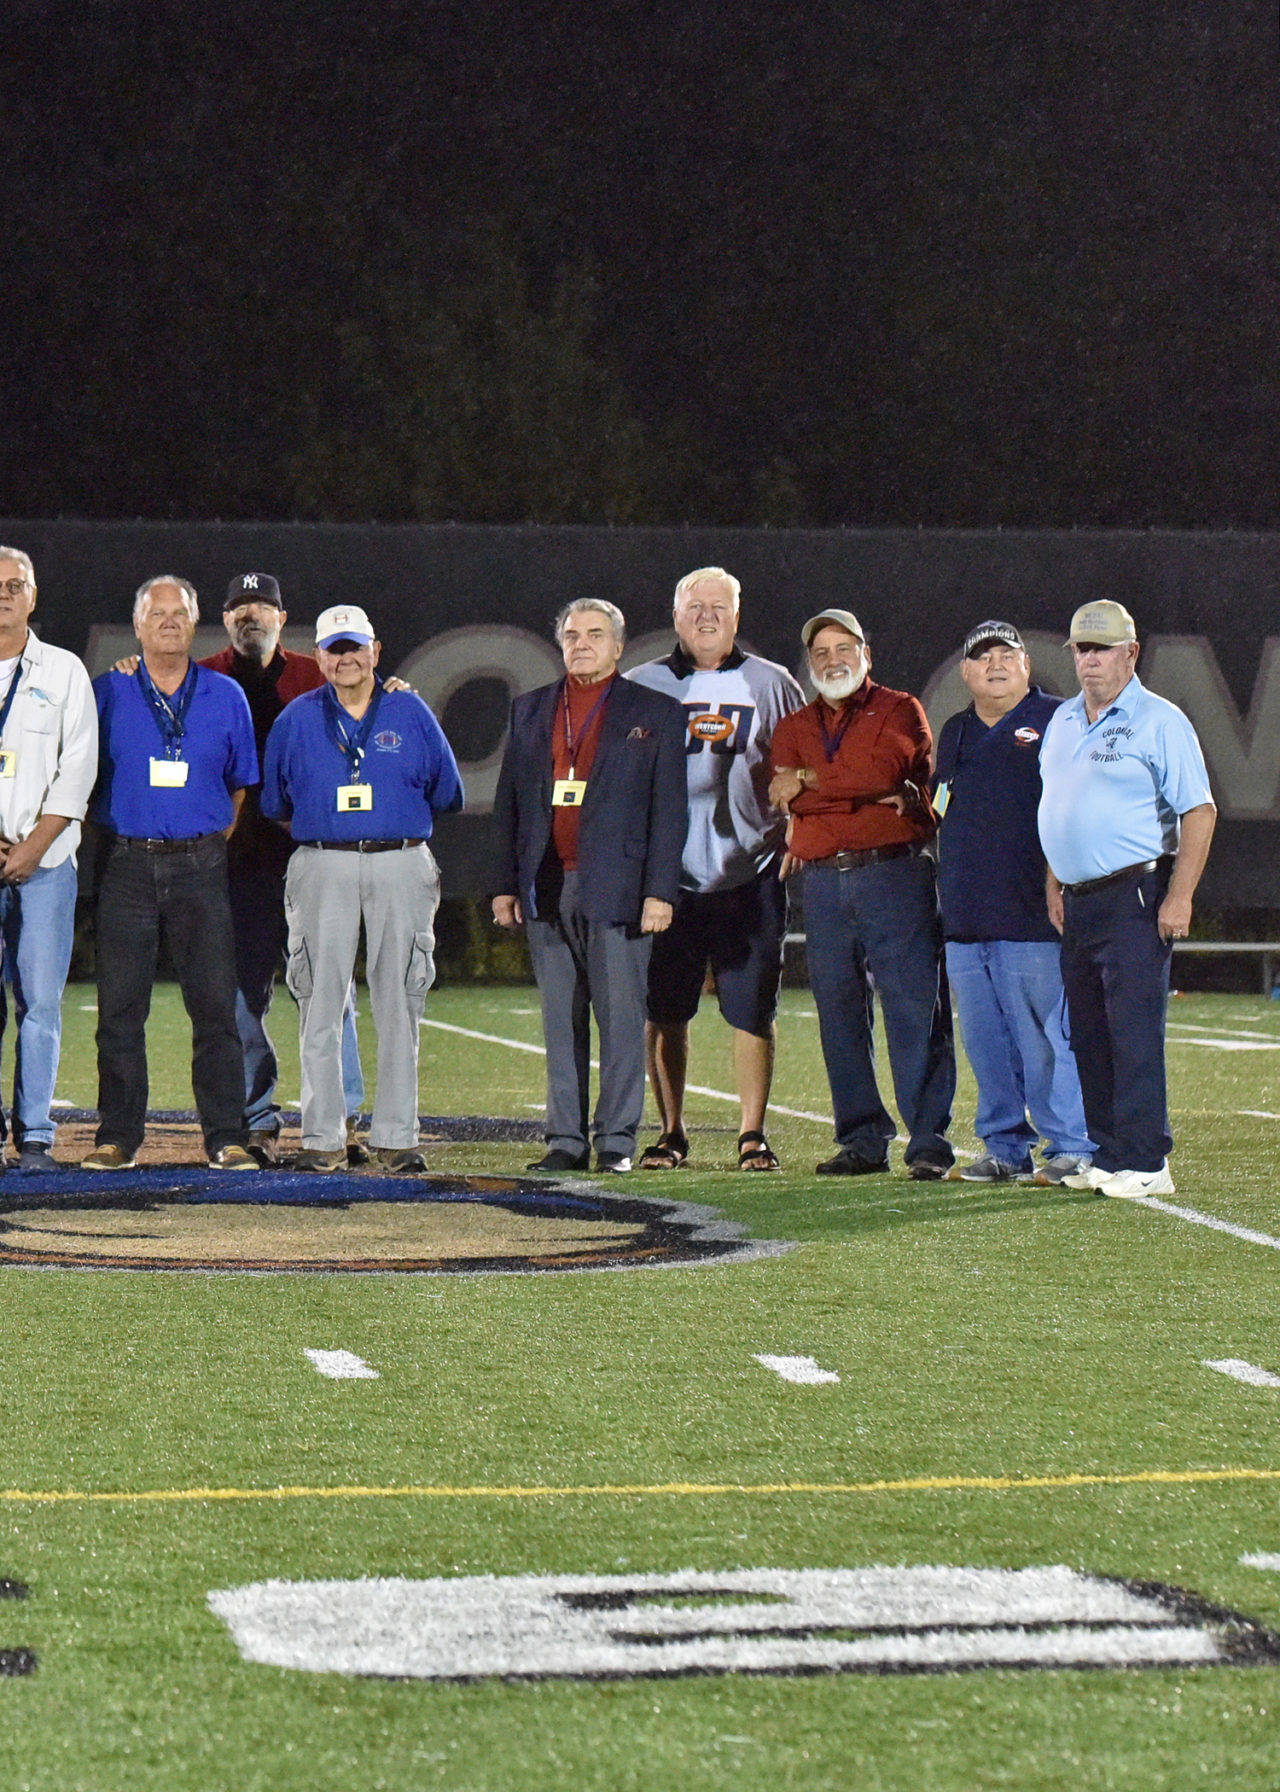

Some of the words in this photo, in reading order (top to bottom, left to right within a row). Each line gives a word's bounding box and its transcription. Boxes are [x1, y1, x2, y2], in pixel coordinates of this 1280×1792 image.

[243, 574, 259, 590] NY
[967, 629, 1015, 647] CHAMPIONS
[1102, 726, 1135, 741] COLONIAL
[1089, 750, 1124, 763] FOOTBALL
